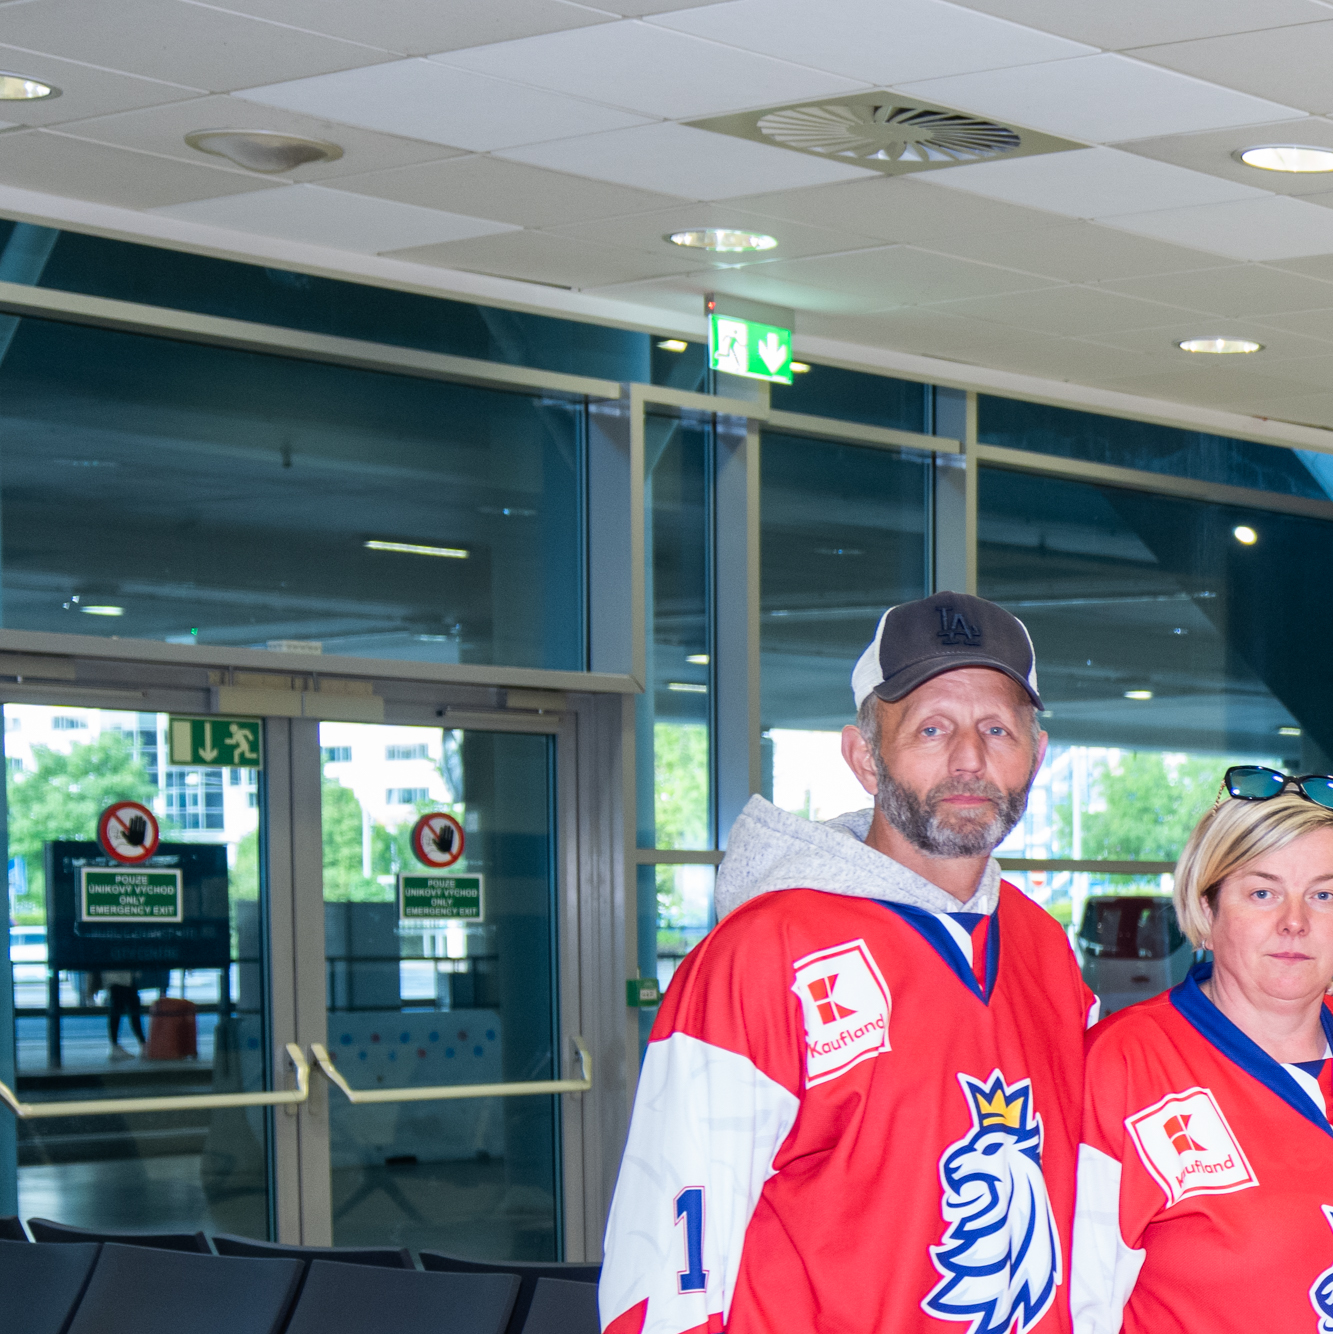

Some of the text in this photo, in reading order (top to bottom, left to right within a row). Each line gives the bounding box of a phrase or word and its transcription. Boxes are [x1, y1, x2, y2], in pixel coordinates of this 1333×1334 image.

[935, 606, 981, 646] LA
[115, 874, 148, 884] POUZE
[427, 878, 456, 888] POUZE
[88, 882, 175, 895] ÚNIKOVÝ VÝCHOD
[443, 887, 478, 898] VÝCHOD
[119, 895, 146, 905] ONLY
[430, 898, 453, 906] ONLY
[89, 905, 175, 915] EMERGENCY EXIT
[406, 906, 477, 916] EMERGENCY EXIT
[808, 1013, 885, 1058] Kaufland
[673, 1185, 710, 1295] 1
